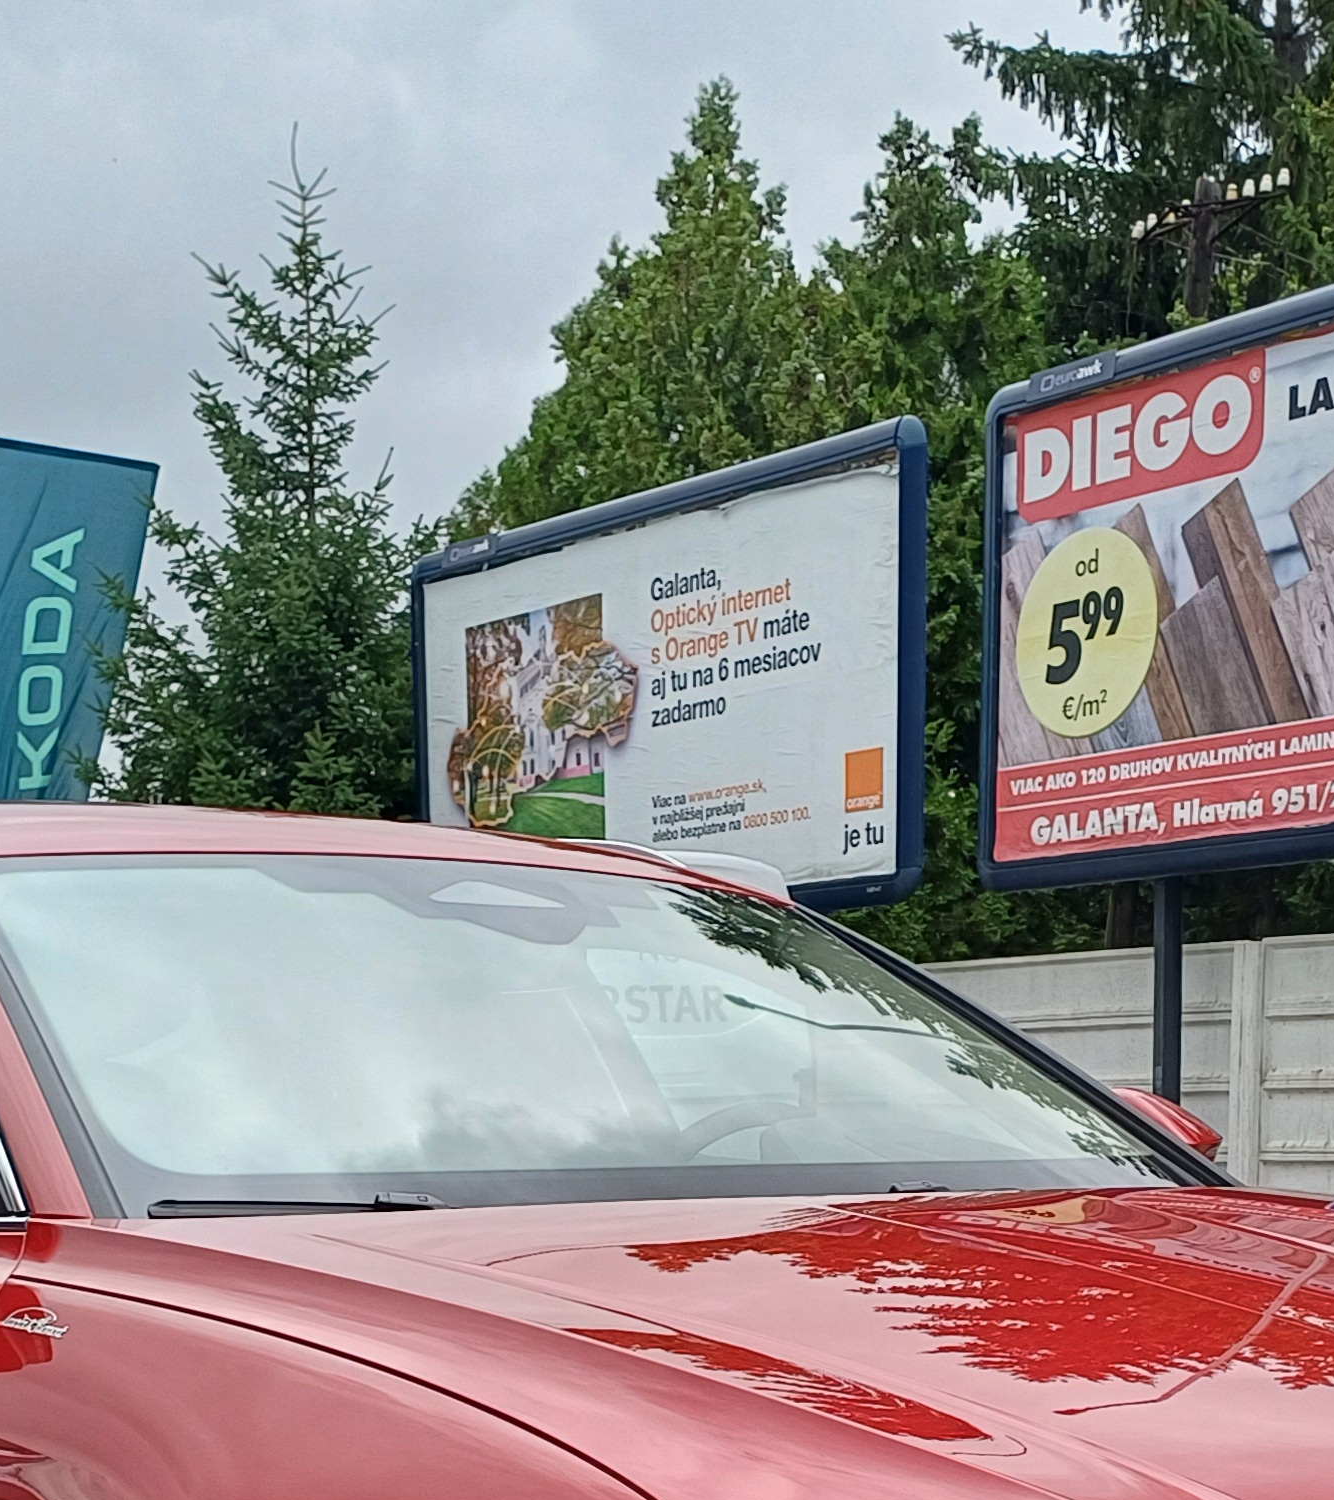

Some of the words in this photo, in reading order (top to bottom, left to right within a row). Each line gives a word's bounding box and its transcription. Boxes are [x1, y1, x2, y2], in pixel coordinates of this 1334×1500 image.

[1023, 374, 1252, 504] DIEGO
[650, 567, 722, 601] Galanta,
[1075, 548, 1100, 577] od
[650, 595, 717, 636] Optický
[721, 578, 792, 616] internet
[15, 526, 86, 791] KODA
[651, 646, 661, 665] s
[665, 630, 729, 661] Orange
[733, 616, 759, 645] TV
[763, 608, 810, 640] máte
[651, 671, 666, 700] aj
[671, 670, 687, 693] tu
[692, 667, 714, 688] na
[718, 657, 729, 682] 6
[734, 642, 822, 679] mesiacov
[651, 696, 727, 728] zadarmo
[1010, 776, 1043, 797] VIAC
[1045, 771, 1077, 792] AKO
[1081, 765, 1107, 786] 120
[1109, 754, 1175, 781] DRUHOV
[1176, 738, 1275, 773] KVALITNÝCH
[651, 795, 673, 808] Viac
[674, 793, 687, 806] na
[729, 819, 742, 832] na
[743, 812, 767, 829] 0800
[770, 809, 789, 825] 500
[847, 794, 880, 809] orange
[1030, 801, 1167, 846] GALANTA,
[1172, 790, 1264, 828] Hlavná
[843, 823, 861, 855] je
[865, 822, 884, 845] tu
